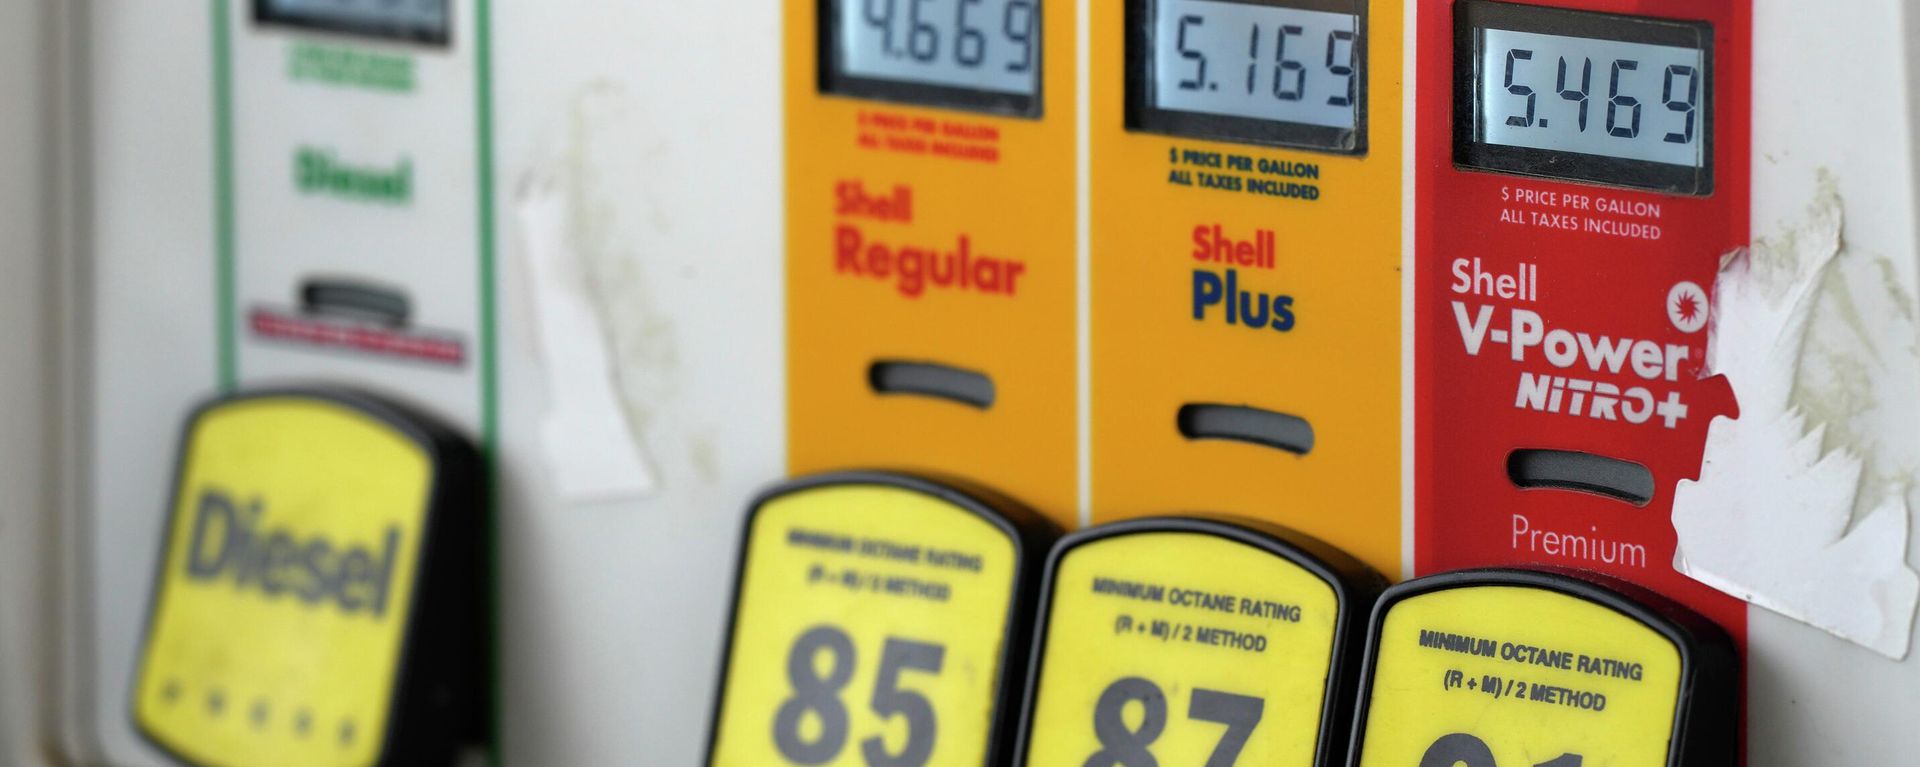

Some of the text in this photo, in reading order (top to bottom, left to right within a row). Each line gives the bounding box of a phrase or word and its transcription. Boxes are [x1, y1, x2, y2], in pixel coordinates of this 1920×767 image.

[1177, 15, 1357, 107] 5.169
[1503, 48, 1698, 144] 5.469
[1168, 171, 1320, 200] ALL TAXES INCLUDED
[1183, 150, 1221, 168] PRICE
[1227, 154, 1252, 172] PER
[1258, 159, 1319, 180] GALLON
[834, 180, 912, 223] Shell
[1500, 208, 1661, 240] ALL TAXES INCLUDED
[1515, 189, 1556, 206] PRICE
[1563, 193, 1590, 210] PER
[1596, 198, 1661, 218] GALLON
[834, 224, 1026, 298] Regular
[1192, 224, 1275, 269] Shell
[1193, 269, 1295, 332] Plus
[1451, 257, 1537, 301] Shell
[1451, 301, 1690, 381] V-Power
[186, 484, 404, 620] Diesel
[1512, 514, 1646, 567] Premium
[1092, 577, 1301, 623] MINIMUM OCTANE RATING
[1196, 627, 1268, 652] METHOD
[1419, 629, 1643, 681] MINIMUM OCTANE RATING
[770, 623, 948, 767] 85
[1516, 682, 1527, 699] 2
[1530, 685, 1606, 712] METHOD
[1081, 676, 1265, 767] 87
